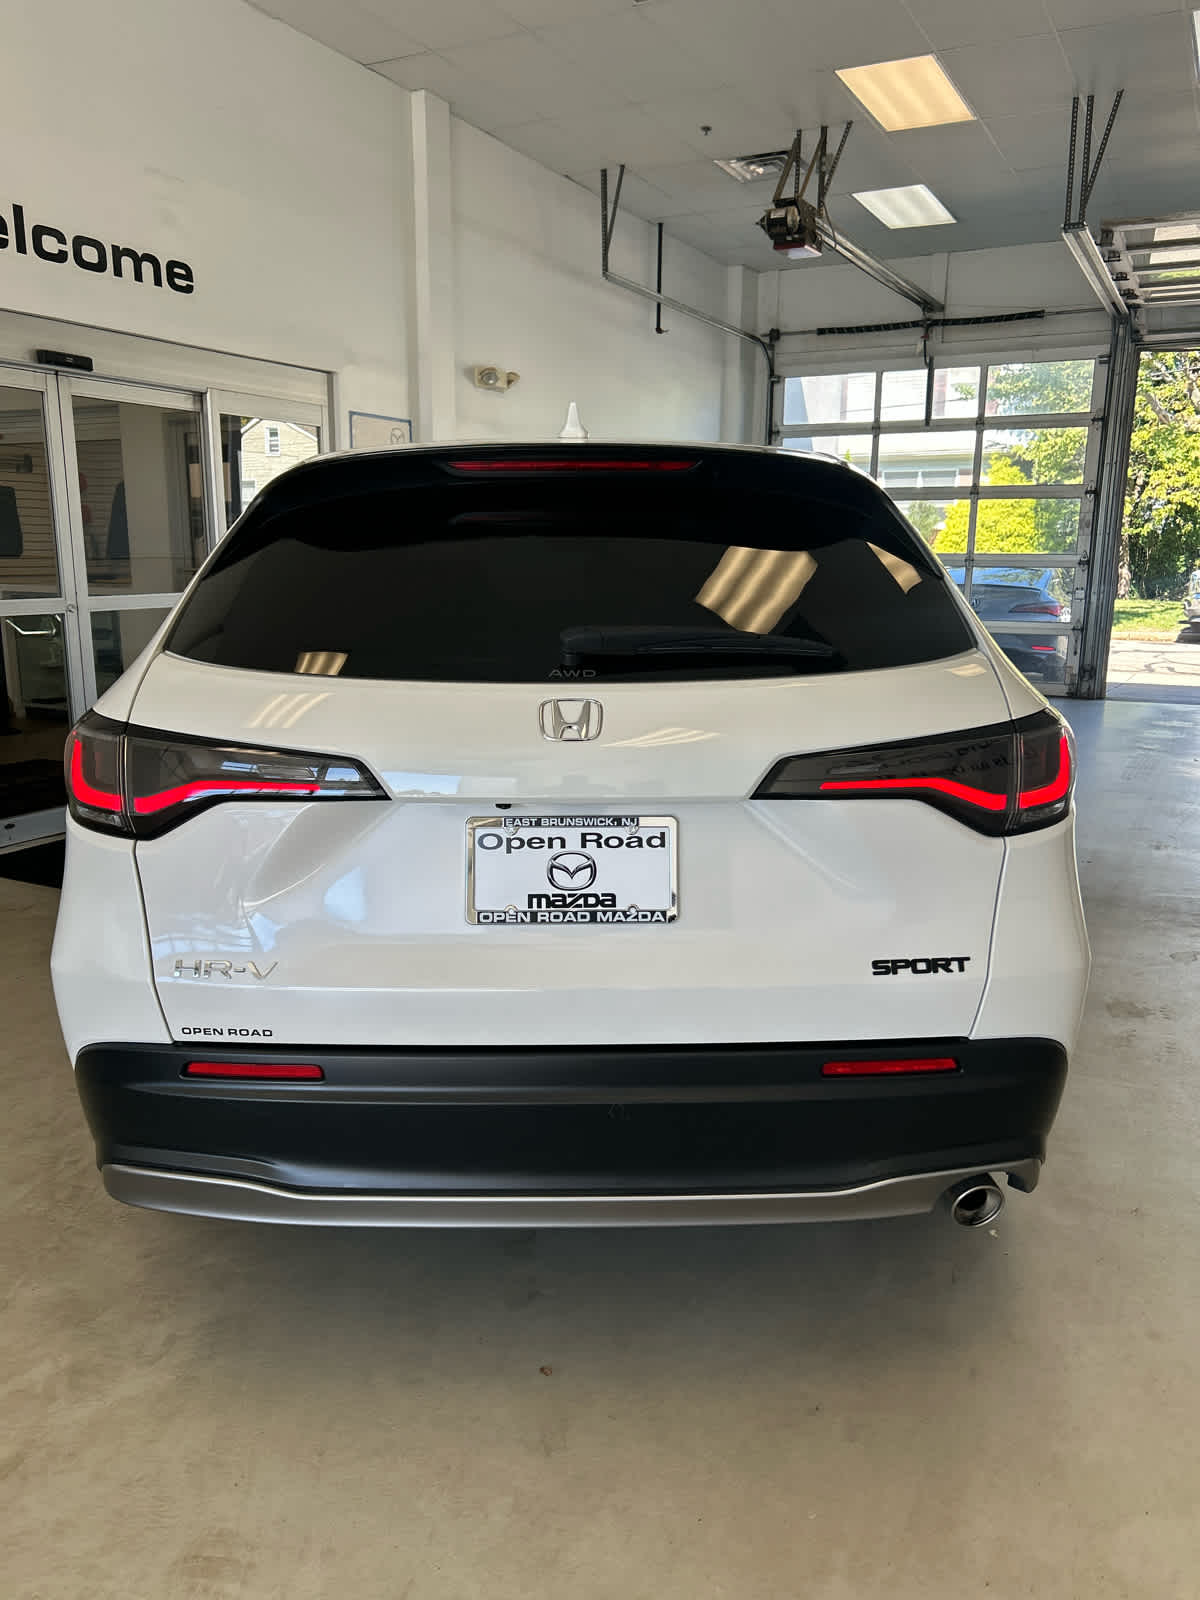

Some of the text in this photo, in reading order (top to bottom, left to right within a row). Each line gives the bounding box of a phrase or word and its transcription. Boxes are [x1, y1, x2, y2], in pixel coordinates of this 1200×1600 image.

[0, 202, 195, 295] lcome
[548, 669, 597, 678] AWD
[505, 818, 639, 827] EAST BRUNSWICK, NJ
[477, 832, 666, 854] Open Road
[479, 912, 666, 923] OPEN ROAD MAZDA
[174, 959, 279, 980] HR-V
[871, 956, 971, 976] SPORT
[181, 1026, 273, 1037] OPEN ROAD
